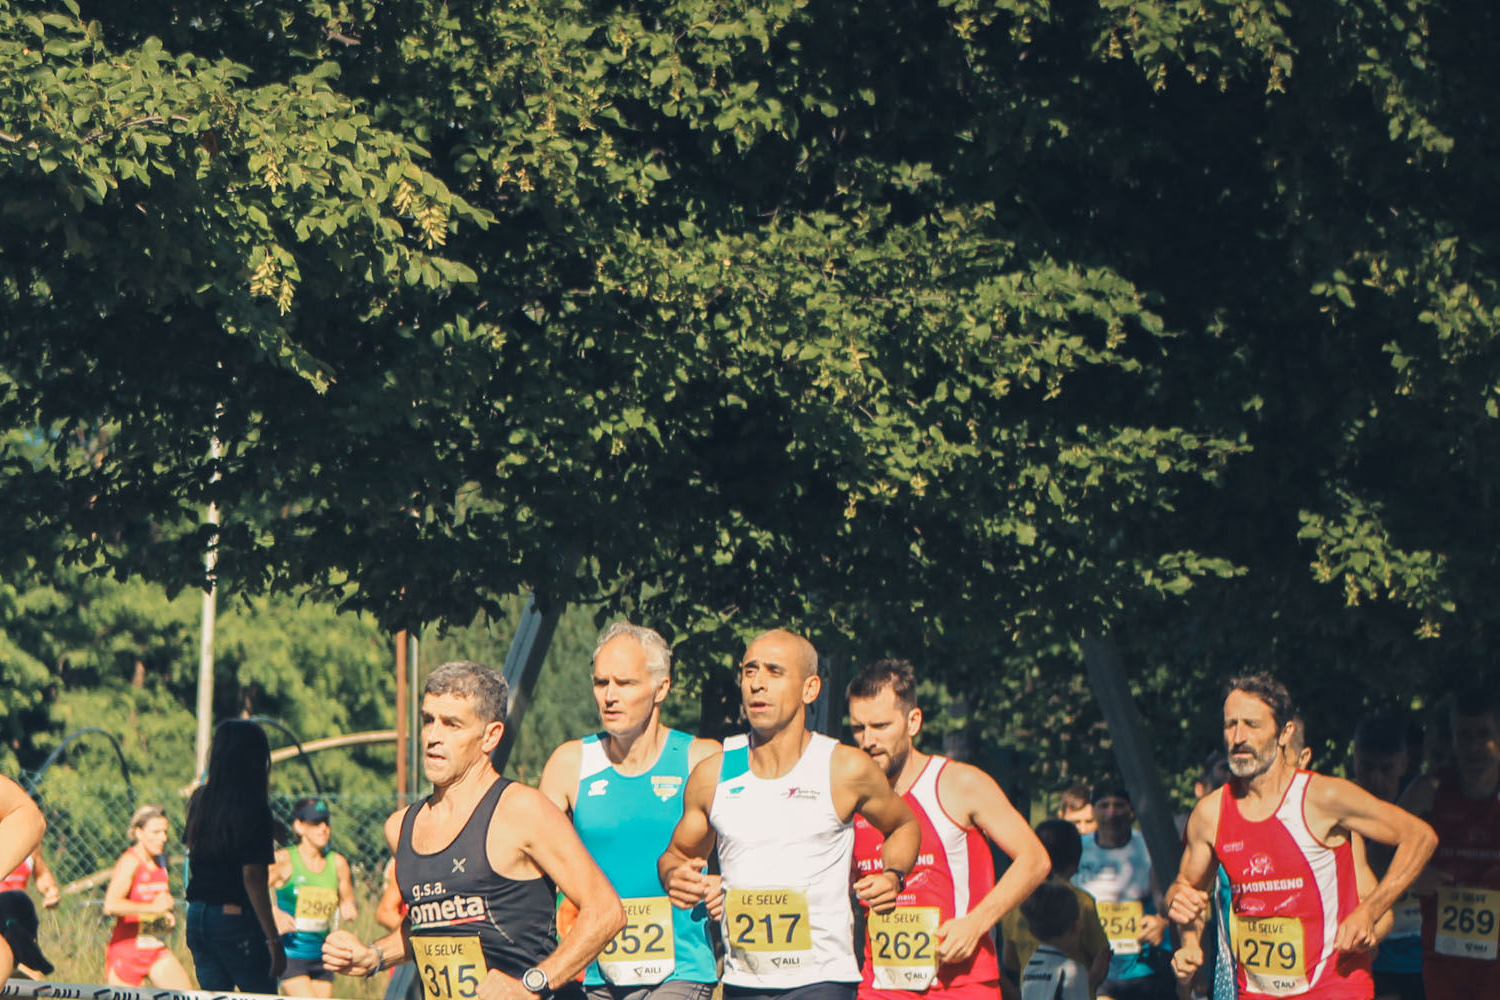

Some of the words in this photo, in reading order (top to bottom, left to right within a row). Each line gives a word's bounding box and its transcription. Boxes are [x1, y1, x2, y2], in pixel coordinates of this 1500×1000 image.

[411, 881, 447, 901] g.s.a.
[742, 894, 753, 905] LE
[756, 894, 788, 906] SELVE
[410, 895, 485, 924] ometa
[894, 913, 921, 923] SELVE
[1443, 905, 1494, 935] 269
[735, 913, 801, 943] 217
[1259, 923, 1285, 935] SELVE
[435, 943, 465, 956] SELVE
[875, 931, 931, 960] 262
[1244, 938, 1296, 970] 279
[782, 957, 800, 965] AILI
[424, 964, 479, 998] 315
